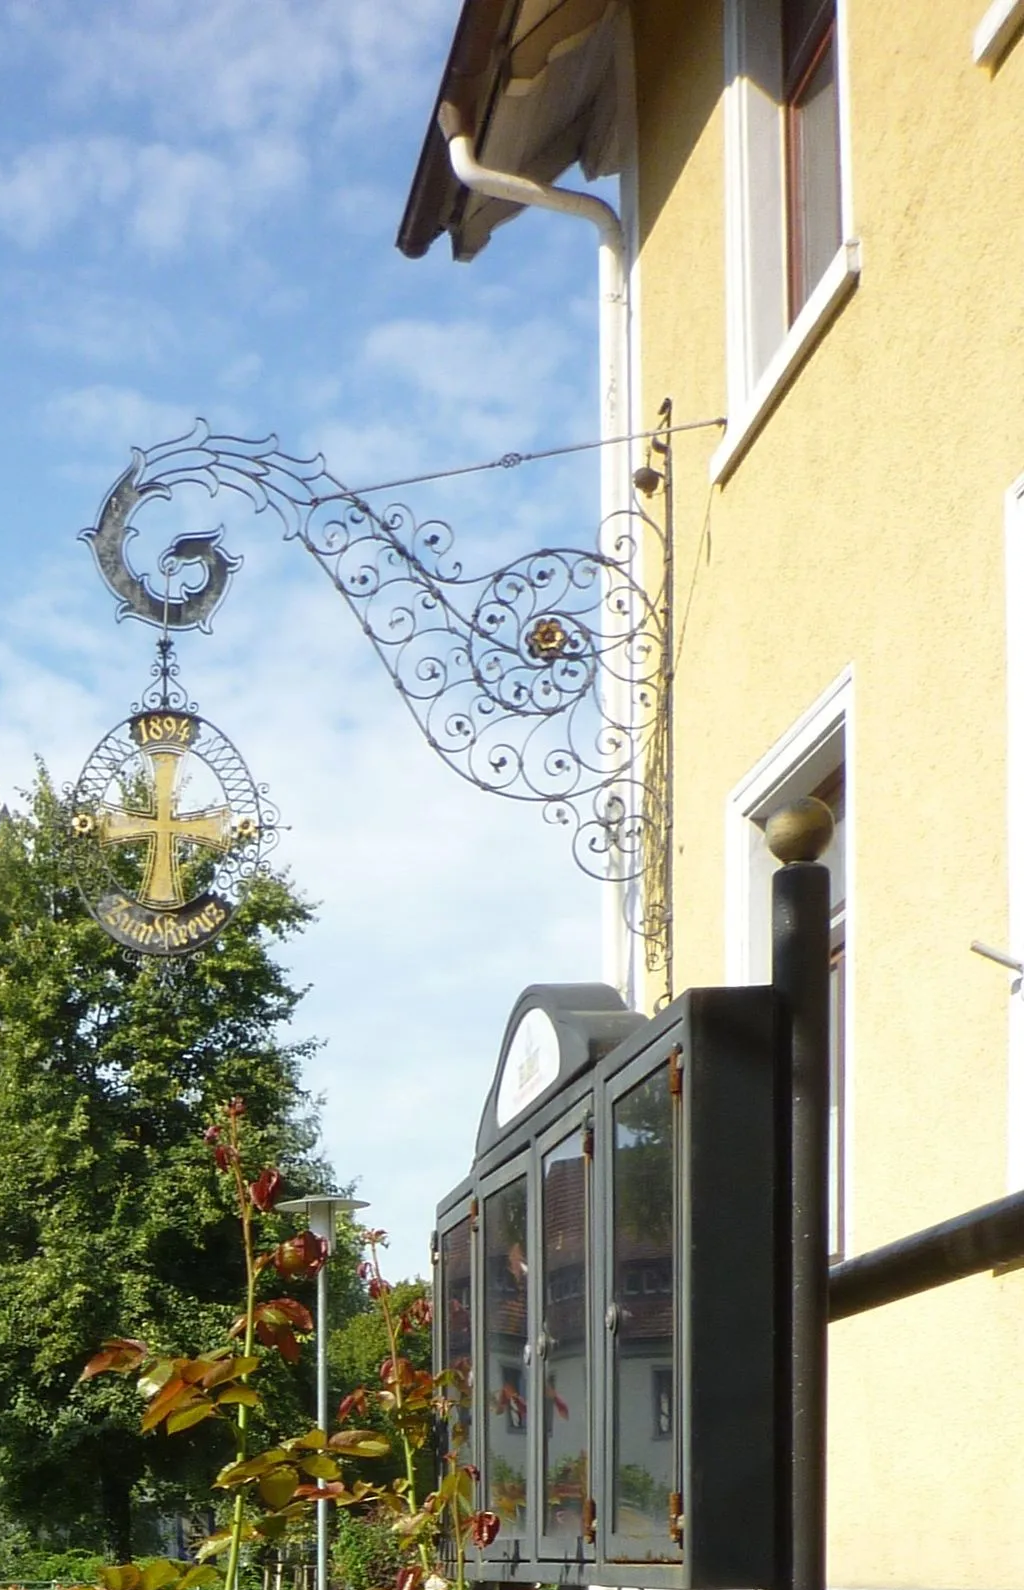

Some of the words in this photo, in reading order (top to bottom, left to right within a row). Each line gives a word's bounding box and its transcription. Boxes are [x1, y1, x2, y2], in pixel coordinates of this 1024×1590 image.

[138, 716, 190, 744] 1894
[106, 898, 153, 945] Zum
[154, 903, 225, 951] Kreuz
